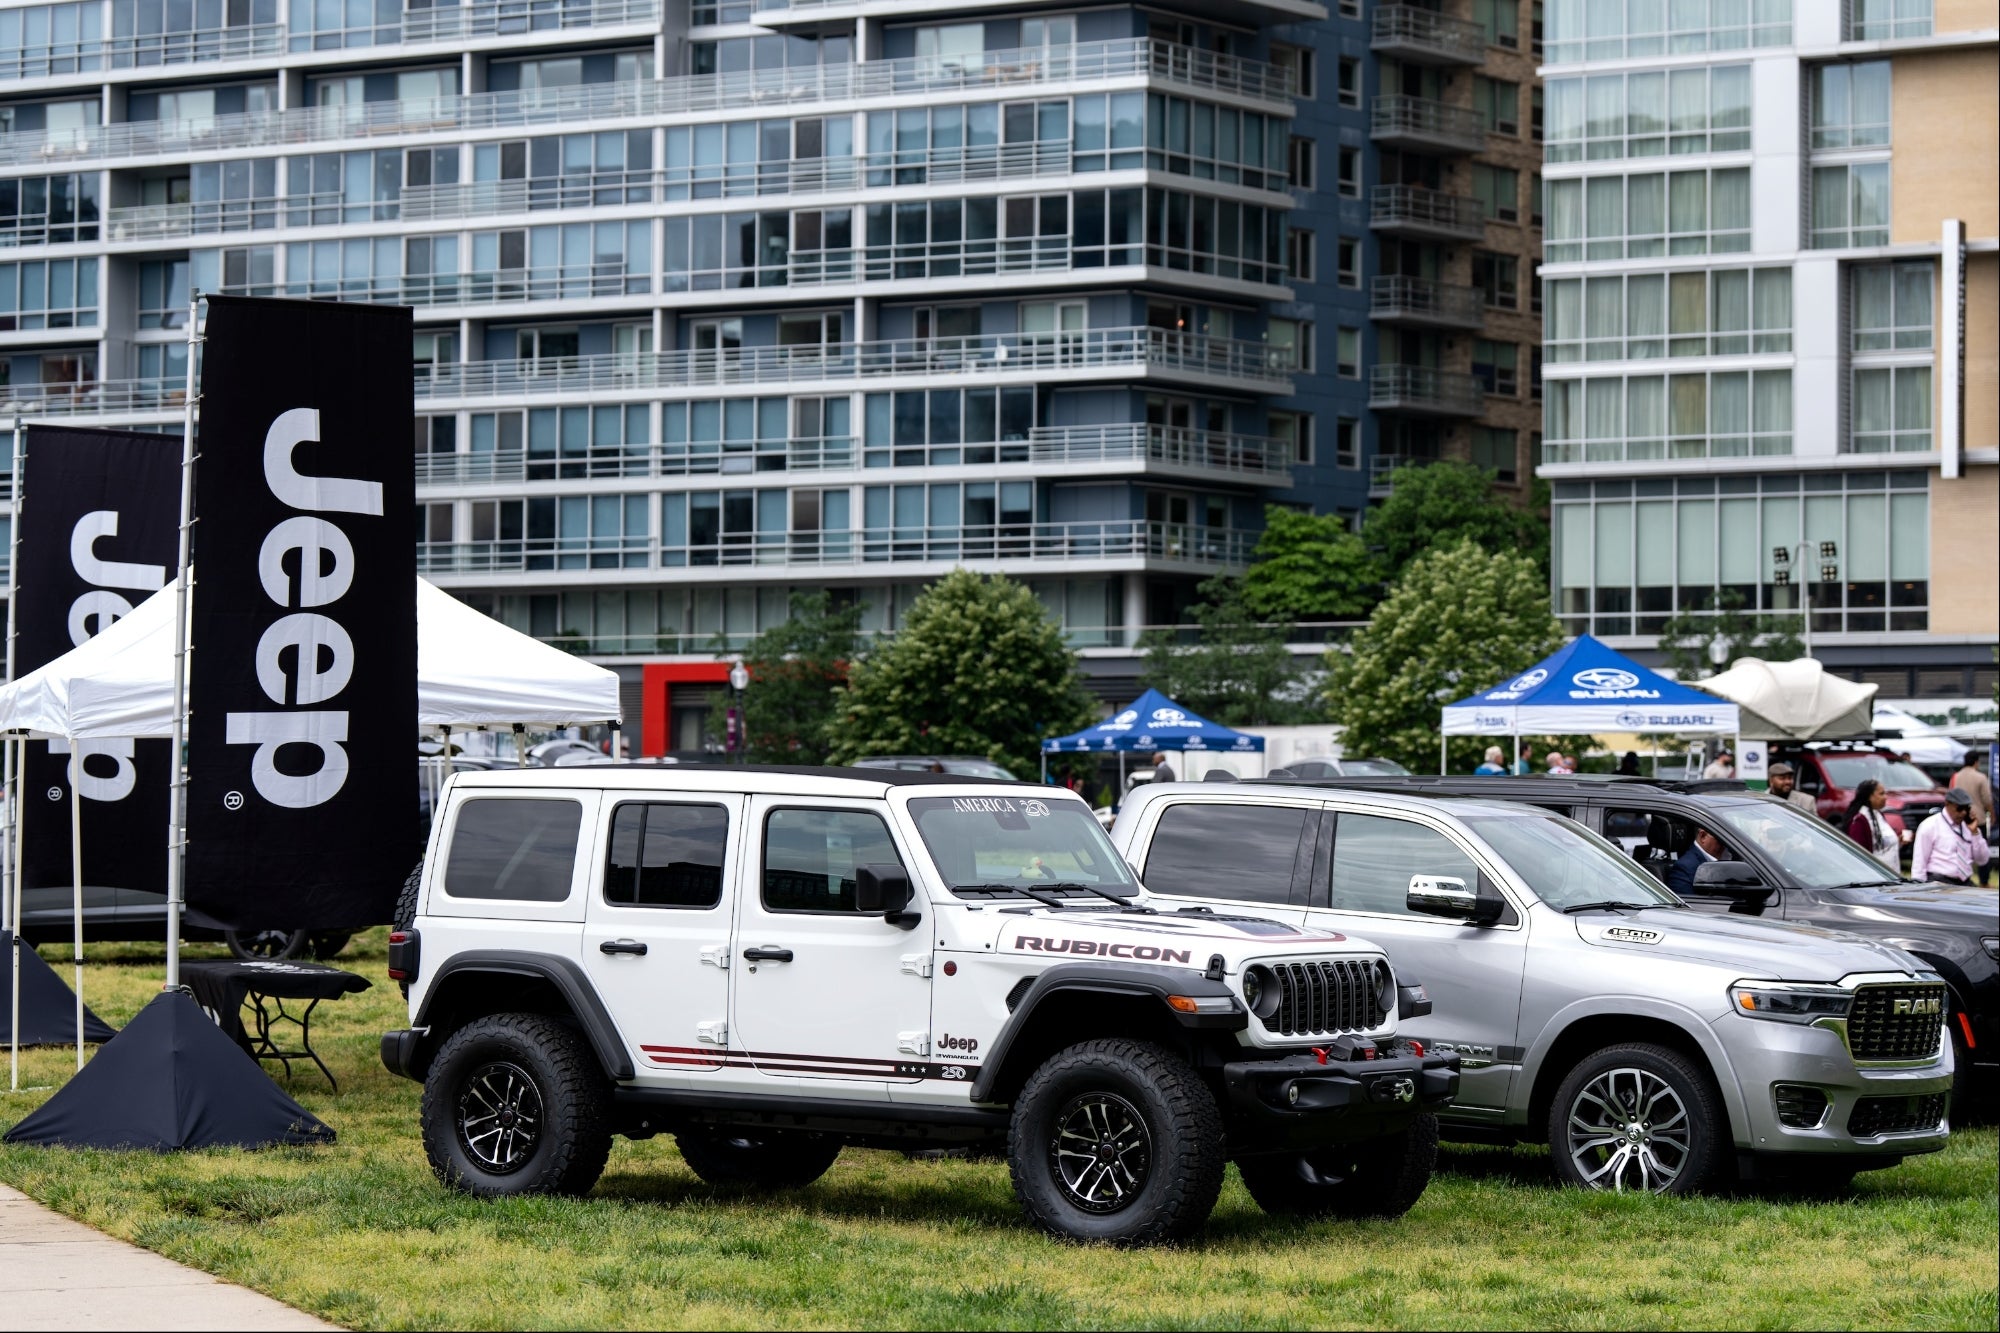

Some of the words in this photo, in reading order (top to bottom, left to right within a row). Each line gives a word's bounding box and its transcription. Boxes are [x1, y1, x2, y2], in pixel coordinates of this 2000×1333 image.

[226, 406, 384, 809] Jeep
[48, 510, 166, 802] Jep
[1568, 689, 1661, 699] SUBARU
[1648, 715, 1714, 726] SUBARU
[952, 798, 1017, 813] AMERICA
[1611, 928, 1657, 940] 1500
[1014, 935, 1192, 964] RUBICON
[1893, 998, 1941, 1016] RAM
[937, 1033, 978, 1054] Jeep
[941, 1065, 967, 1080] 250
